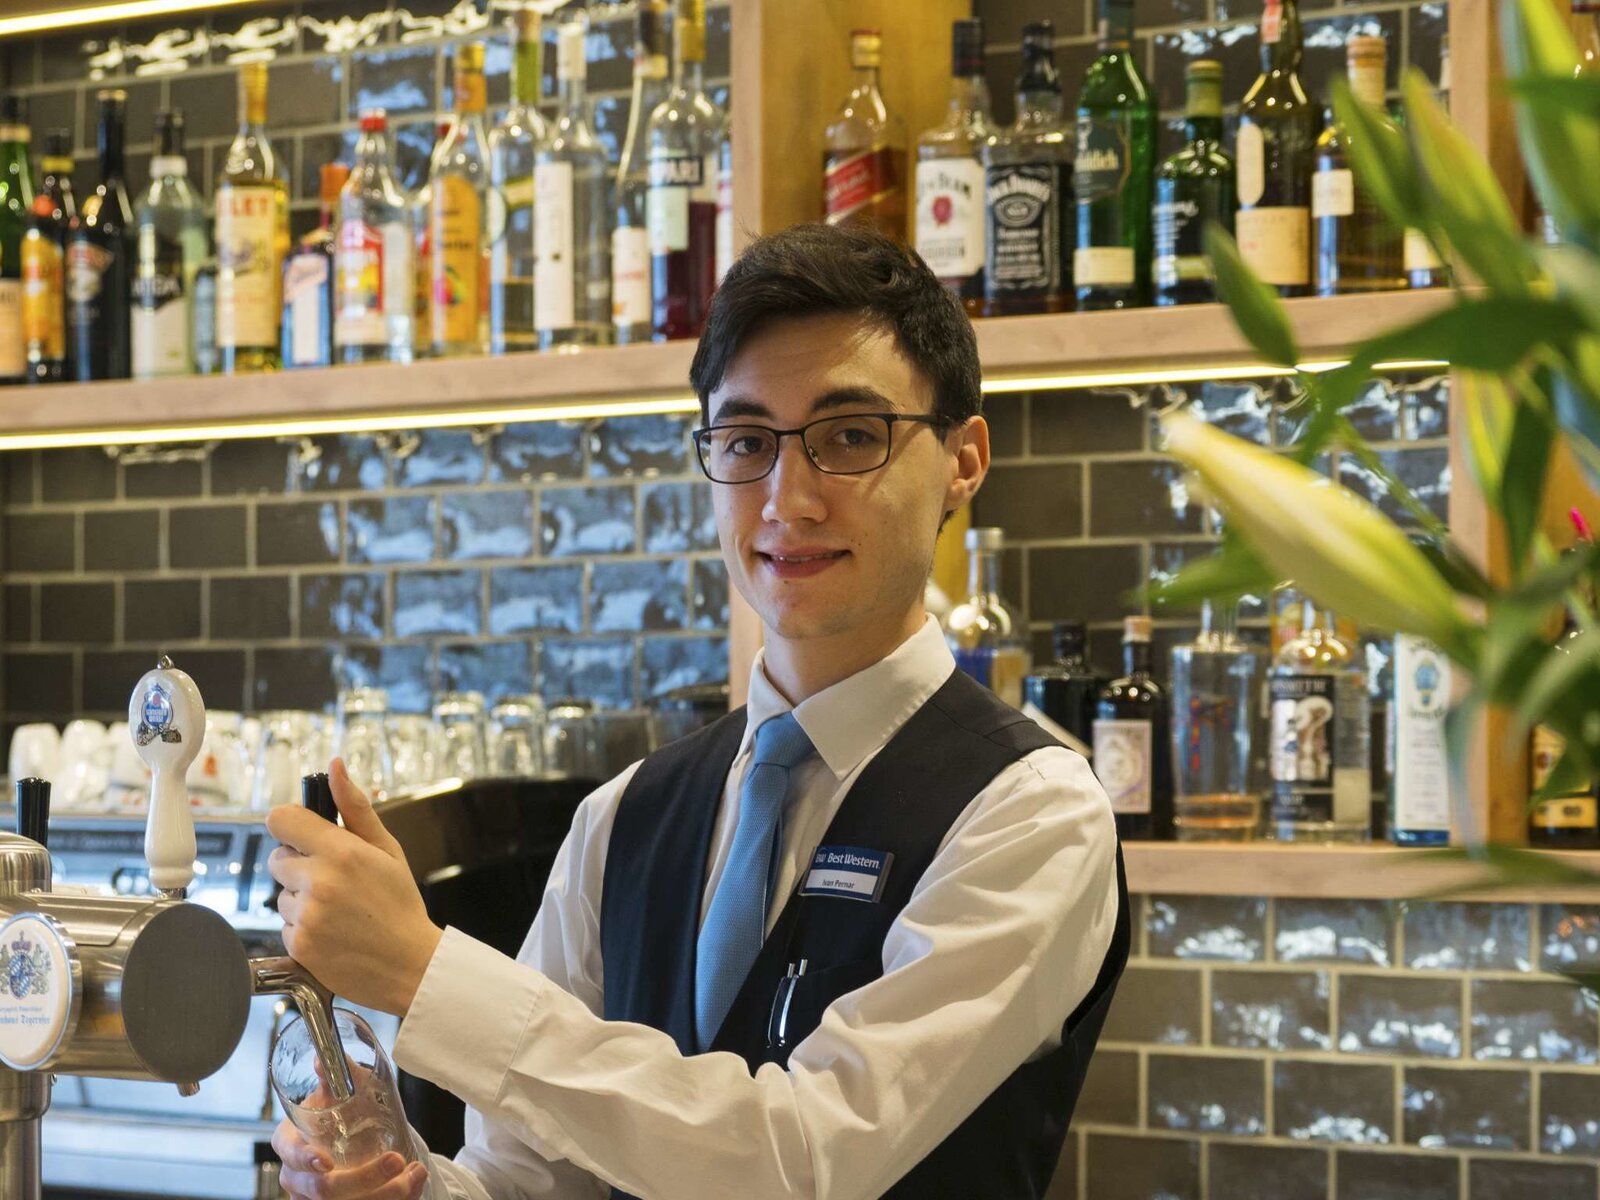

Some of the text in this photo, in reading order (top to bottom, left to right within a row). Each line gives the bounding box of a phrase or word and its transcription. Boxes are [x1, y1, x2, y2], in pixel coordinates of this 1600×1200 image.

[827, 852, 845, 864] Best
[844, 853, 880, 869] Western
[821, 879, 855, 889] Ivan Pernar
